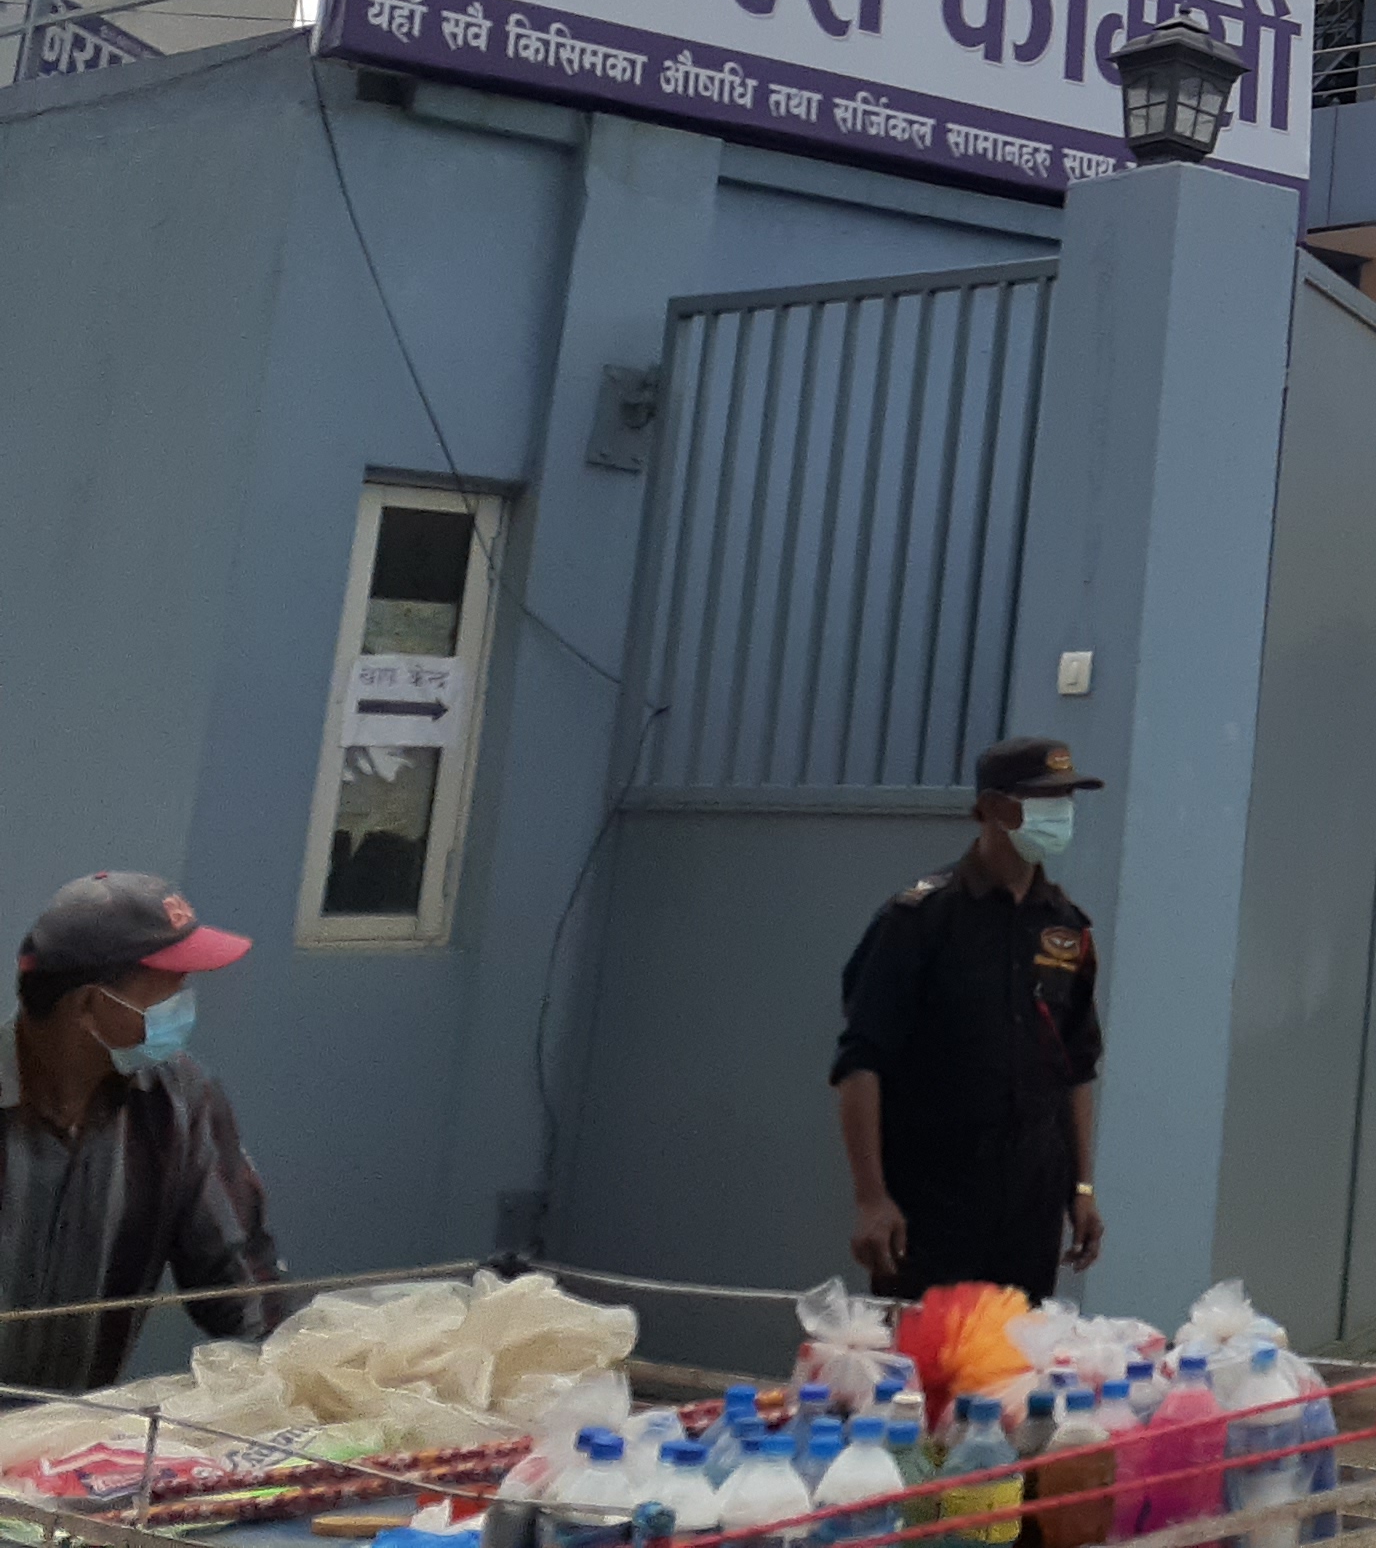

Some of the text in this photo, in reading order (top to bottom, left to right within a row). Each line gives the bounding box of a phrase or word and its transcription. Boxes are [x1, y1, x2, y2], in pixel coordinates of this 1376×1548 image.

[504, 13, 649, 87] किसिमका
[659, 49, 760, 111] औषधि
[768, 83, 823, 124] तथा
[833, 92, 936, 150] सर्जिकल
[945, 122, 1053, 180] सामानहरु
